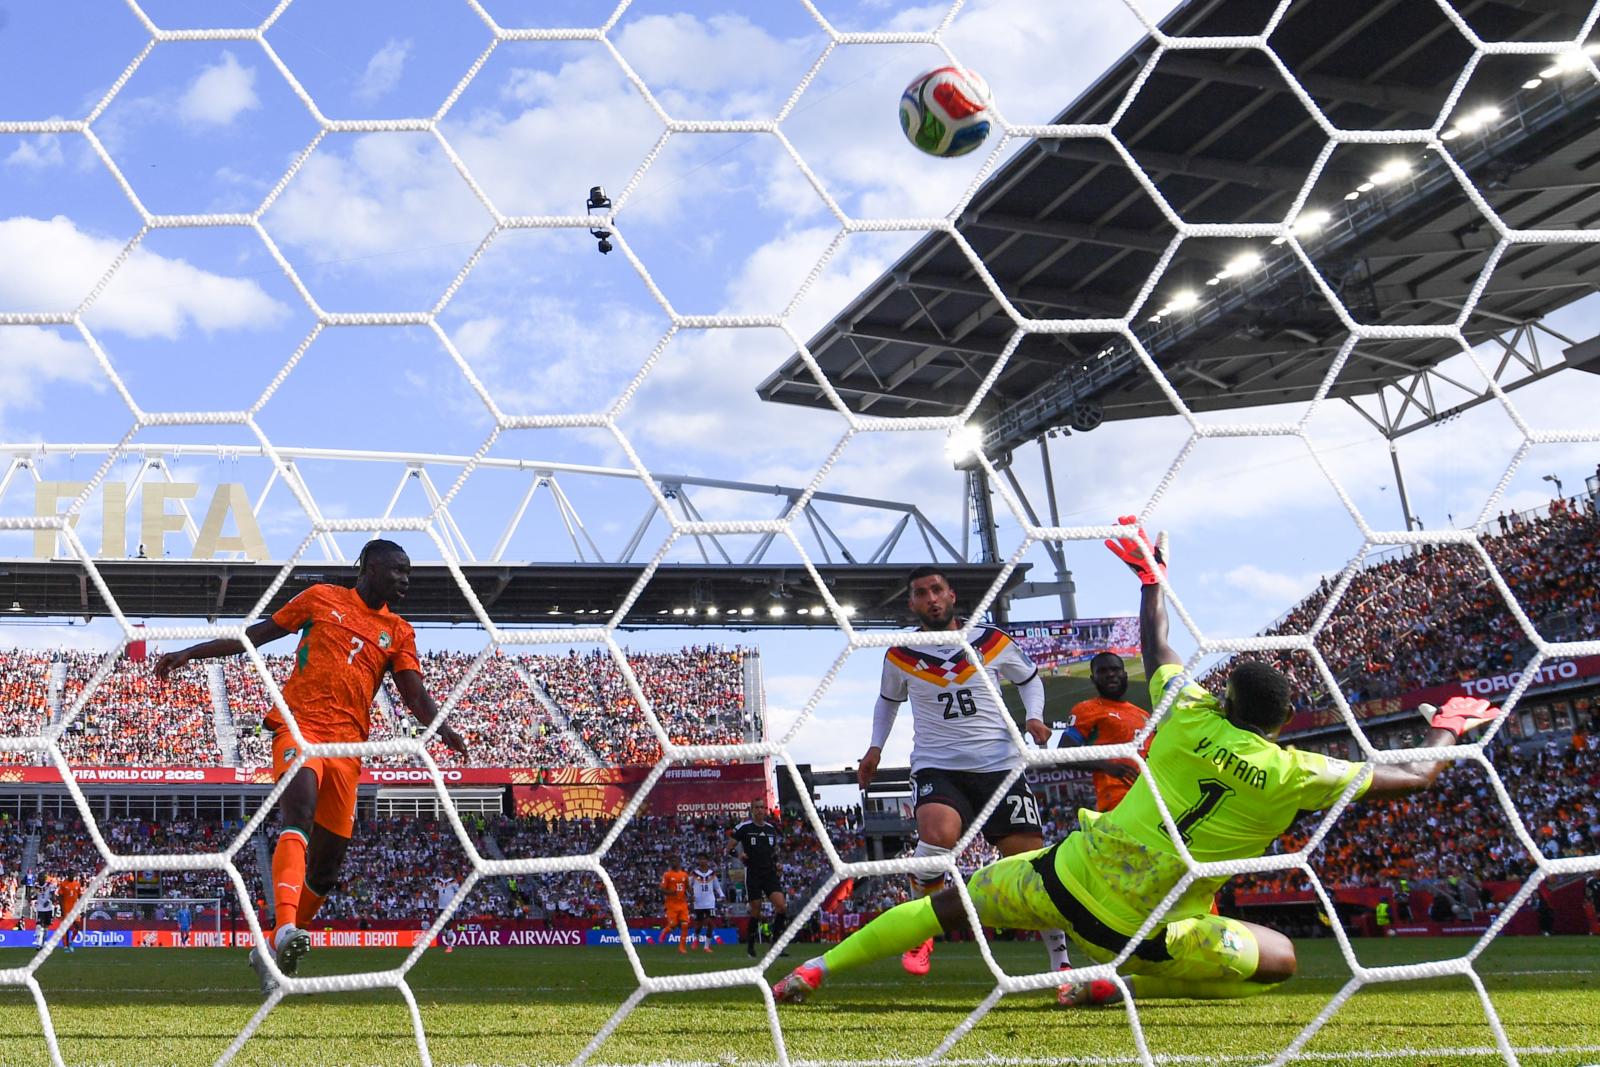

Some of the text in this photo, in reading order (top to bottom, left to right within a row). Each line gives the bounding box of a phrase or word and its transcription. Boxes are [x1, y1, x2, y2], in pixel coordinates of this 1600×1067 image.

[33, 482, 271, 560] FIFA
[347, 636, 365, 665] 7
[1461, 661, 1578, 696] TORONTO
[938, 689, 977, 720] 26
[72, 770, 205, 780] FIFA WORLD CUP 2026
[369, 770, 462, 781] TORONTO
[665, 769, 721, 778] #FIFAWorldCup
[1202, 745, 1267, 790] OFANA
[677, 803, 706, 811] COUPE
[707, 803, 720, 811] DU
[1006, 795, 1038, 826] 26
[1158, 778, 1236, 848] 1
[194, 932, 226, 947] HOME
[229, 932, 257, 947] EPO
[309, 932, 327, 947] THE
[330, 932, 361, 947] HOME
[364, 932, 399, 947] DEPOT
[442, 930, 501, 946] QATAR
[508, 930, 581, 945] AIRWAYS
[600, 934, 642, 944] Amean
